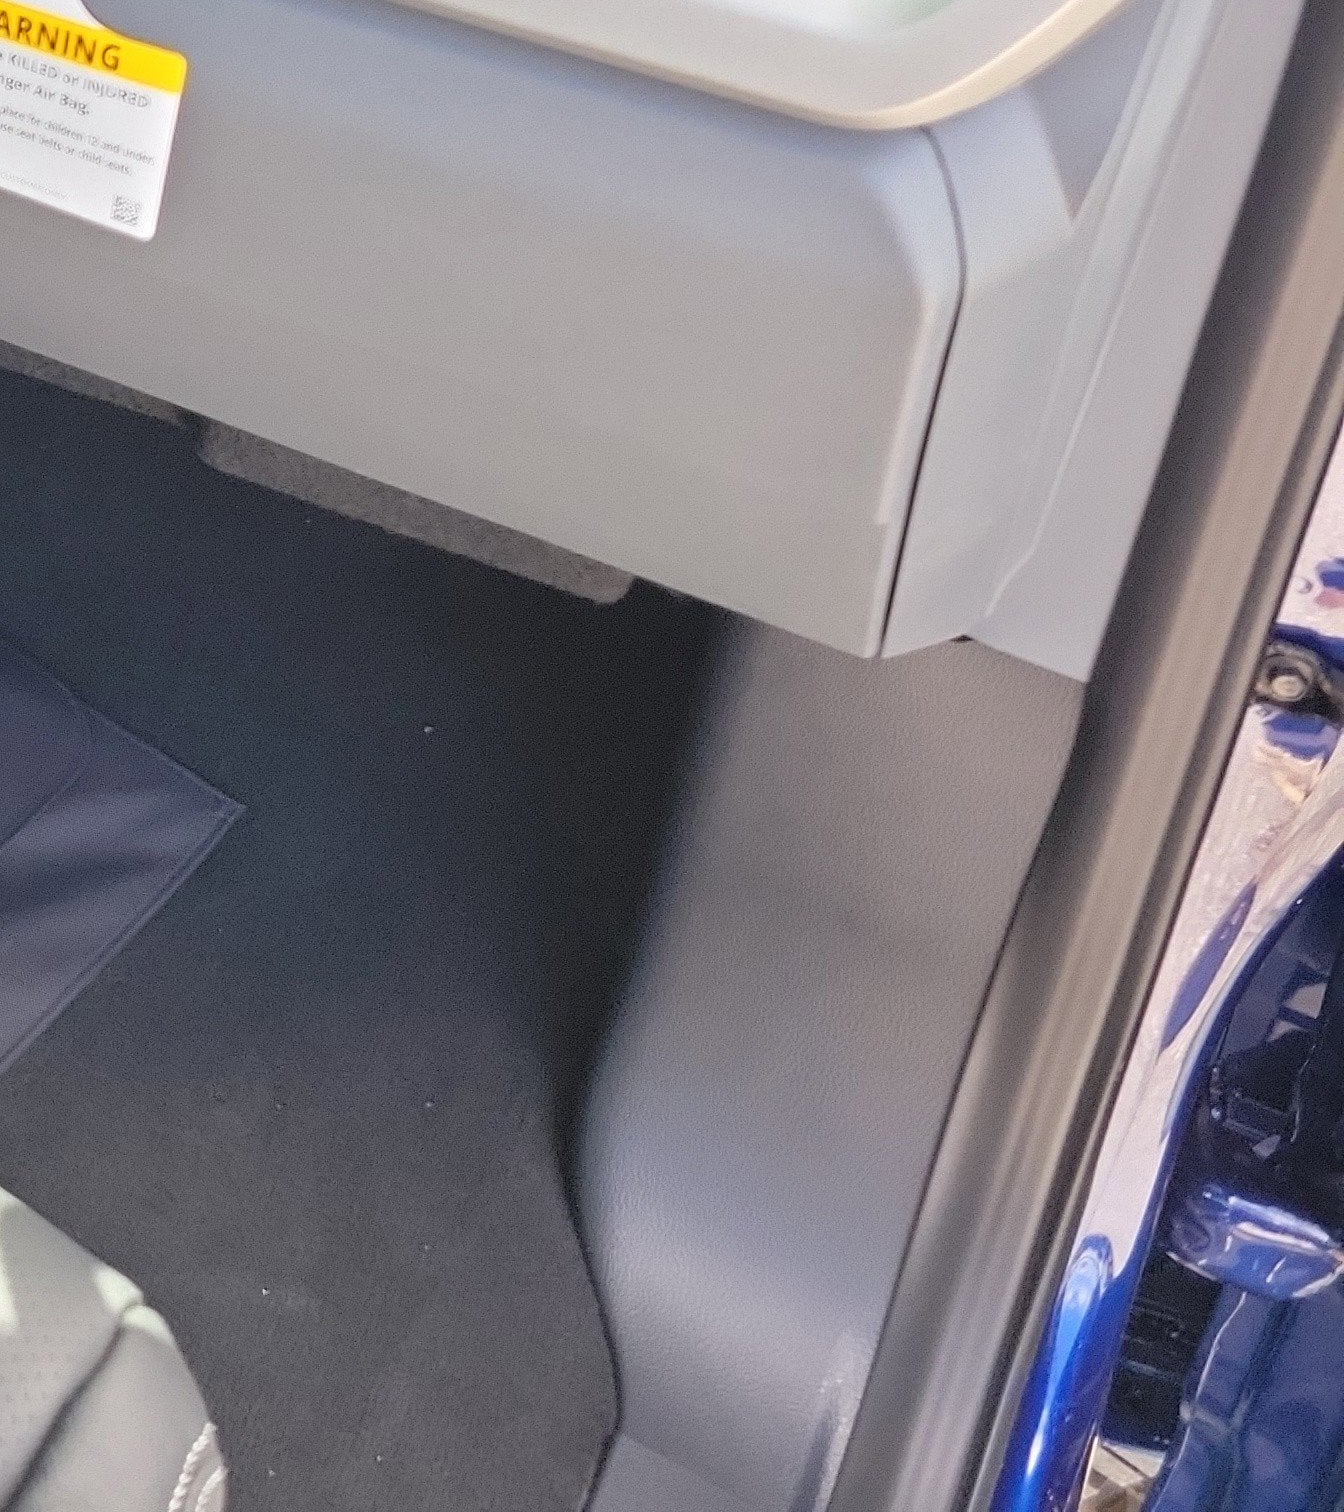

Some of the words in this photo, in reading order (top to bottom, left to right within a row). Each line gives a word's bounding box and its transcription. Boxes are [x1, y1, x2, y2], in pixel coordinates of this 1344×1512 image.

[9, 53, 58, 79] KILLED
[64, 73, 79, 86] or
[82, 78, 151, 108] INJURED
[32, 85, 56, 101] Air
[61, 93, 90, 117] Bag.
[44, 119, 83, 142] children
